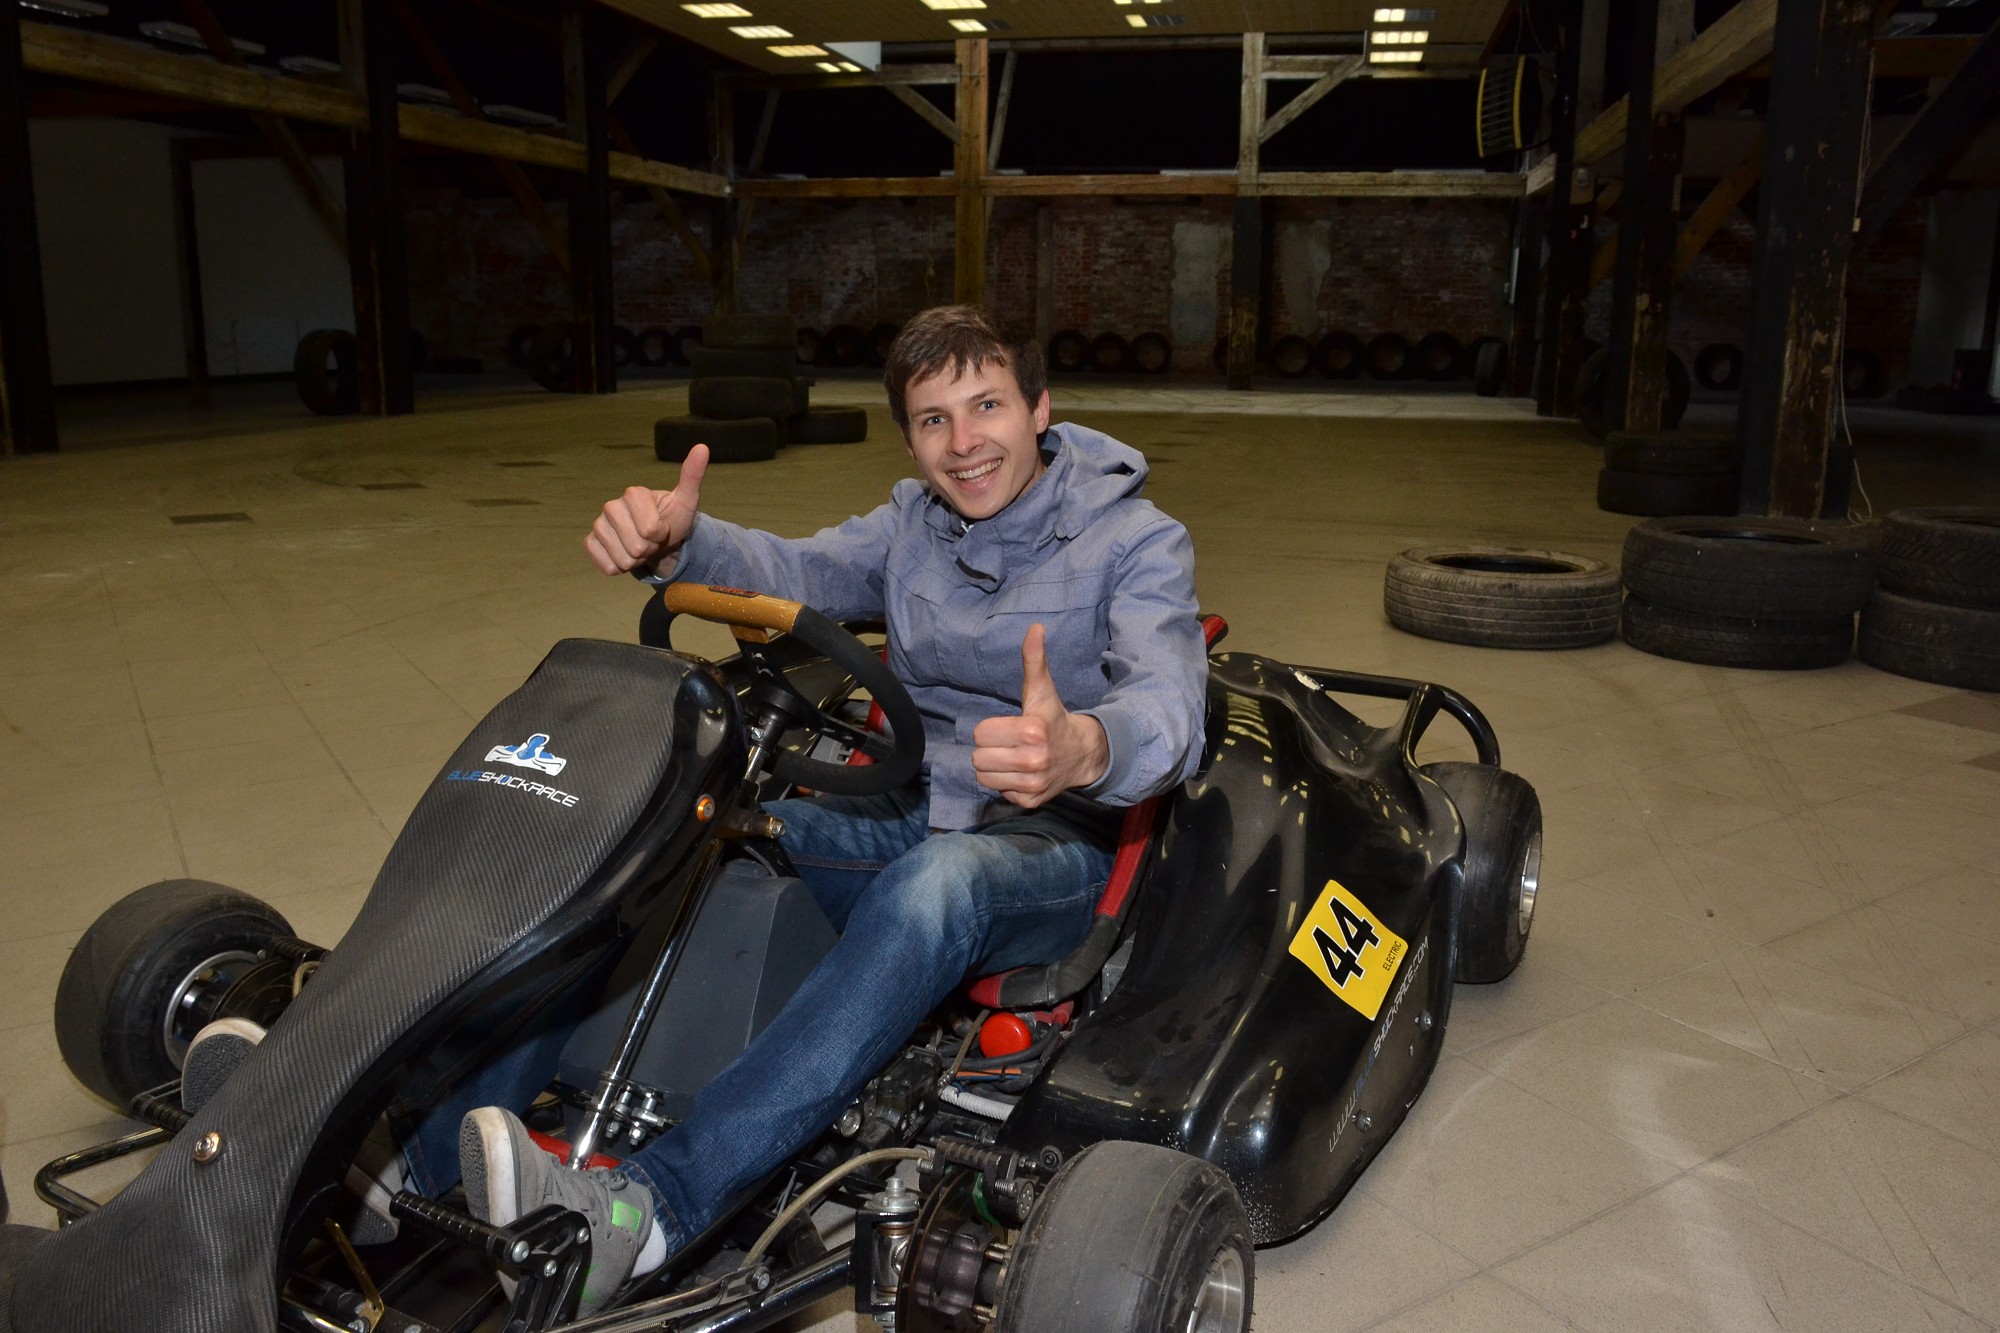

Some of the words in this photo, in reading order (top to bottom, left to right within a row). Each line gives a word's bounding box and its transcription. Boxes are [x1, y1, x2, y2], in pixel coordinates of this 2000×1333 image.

[447, 769, 579, 808] BLUESHOCKRACE
[1313, 896, 1380, 988] 44
[1382, 940, 1402, 971] ELECTRIC
